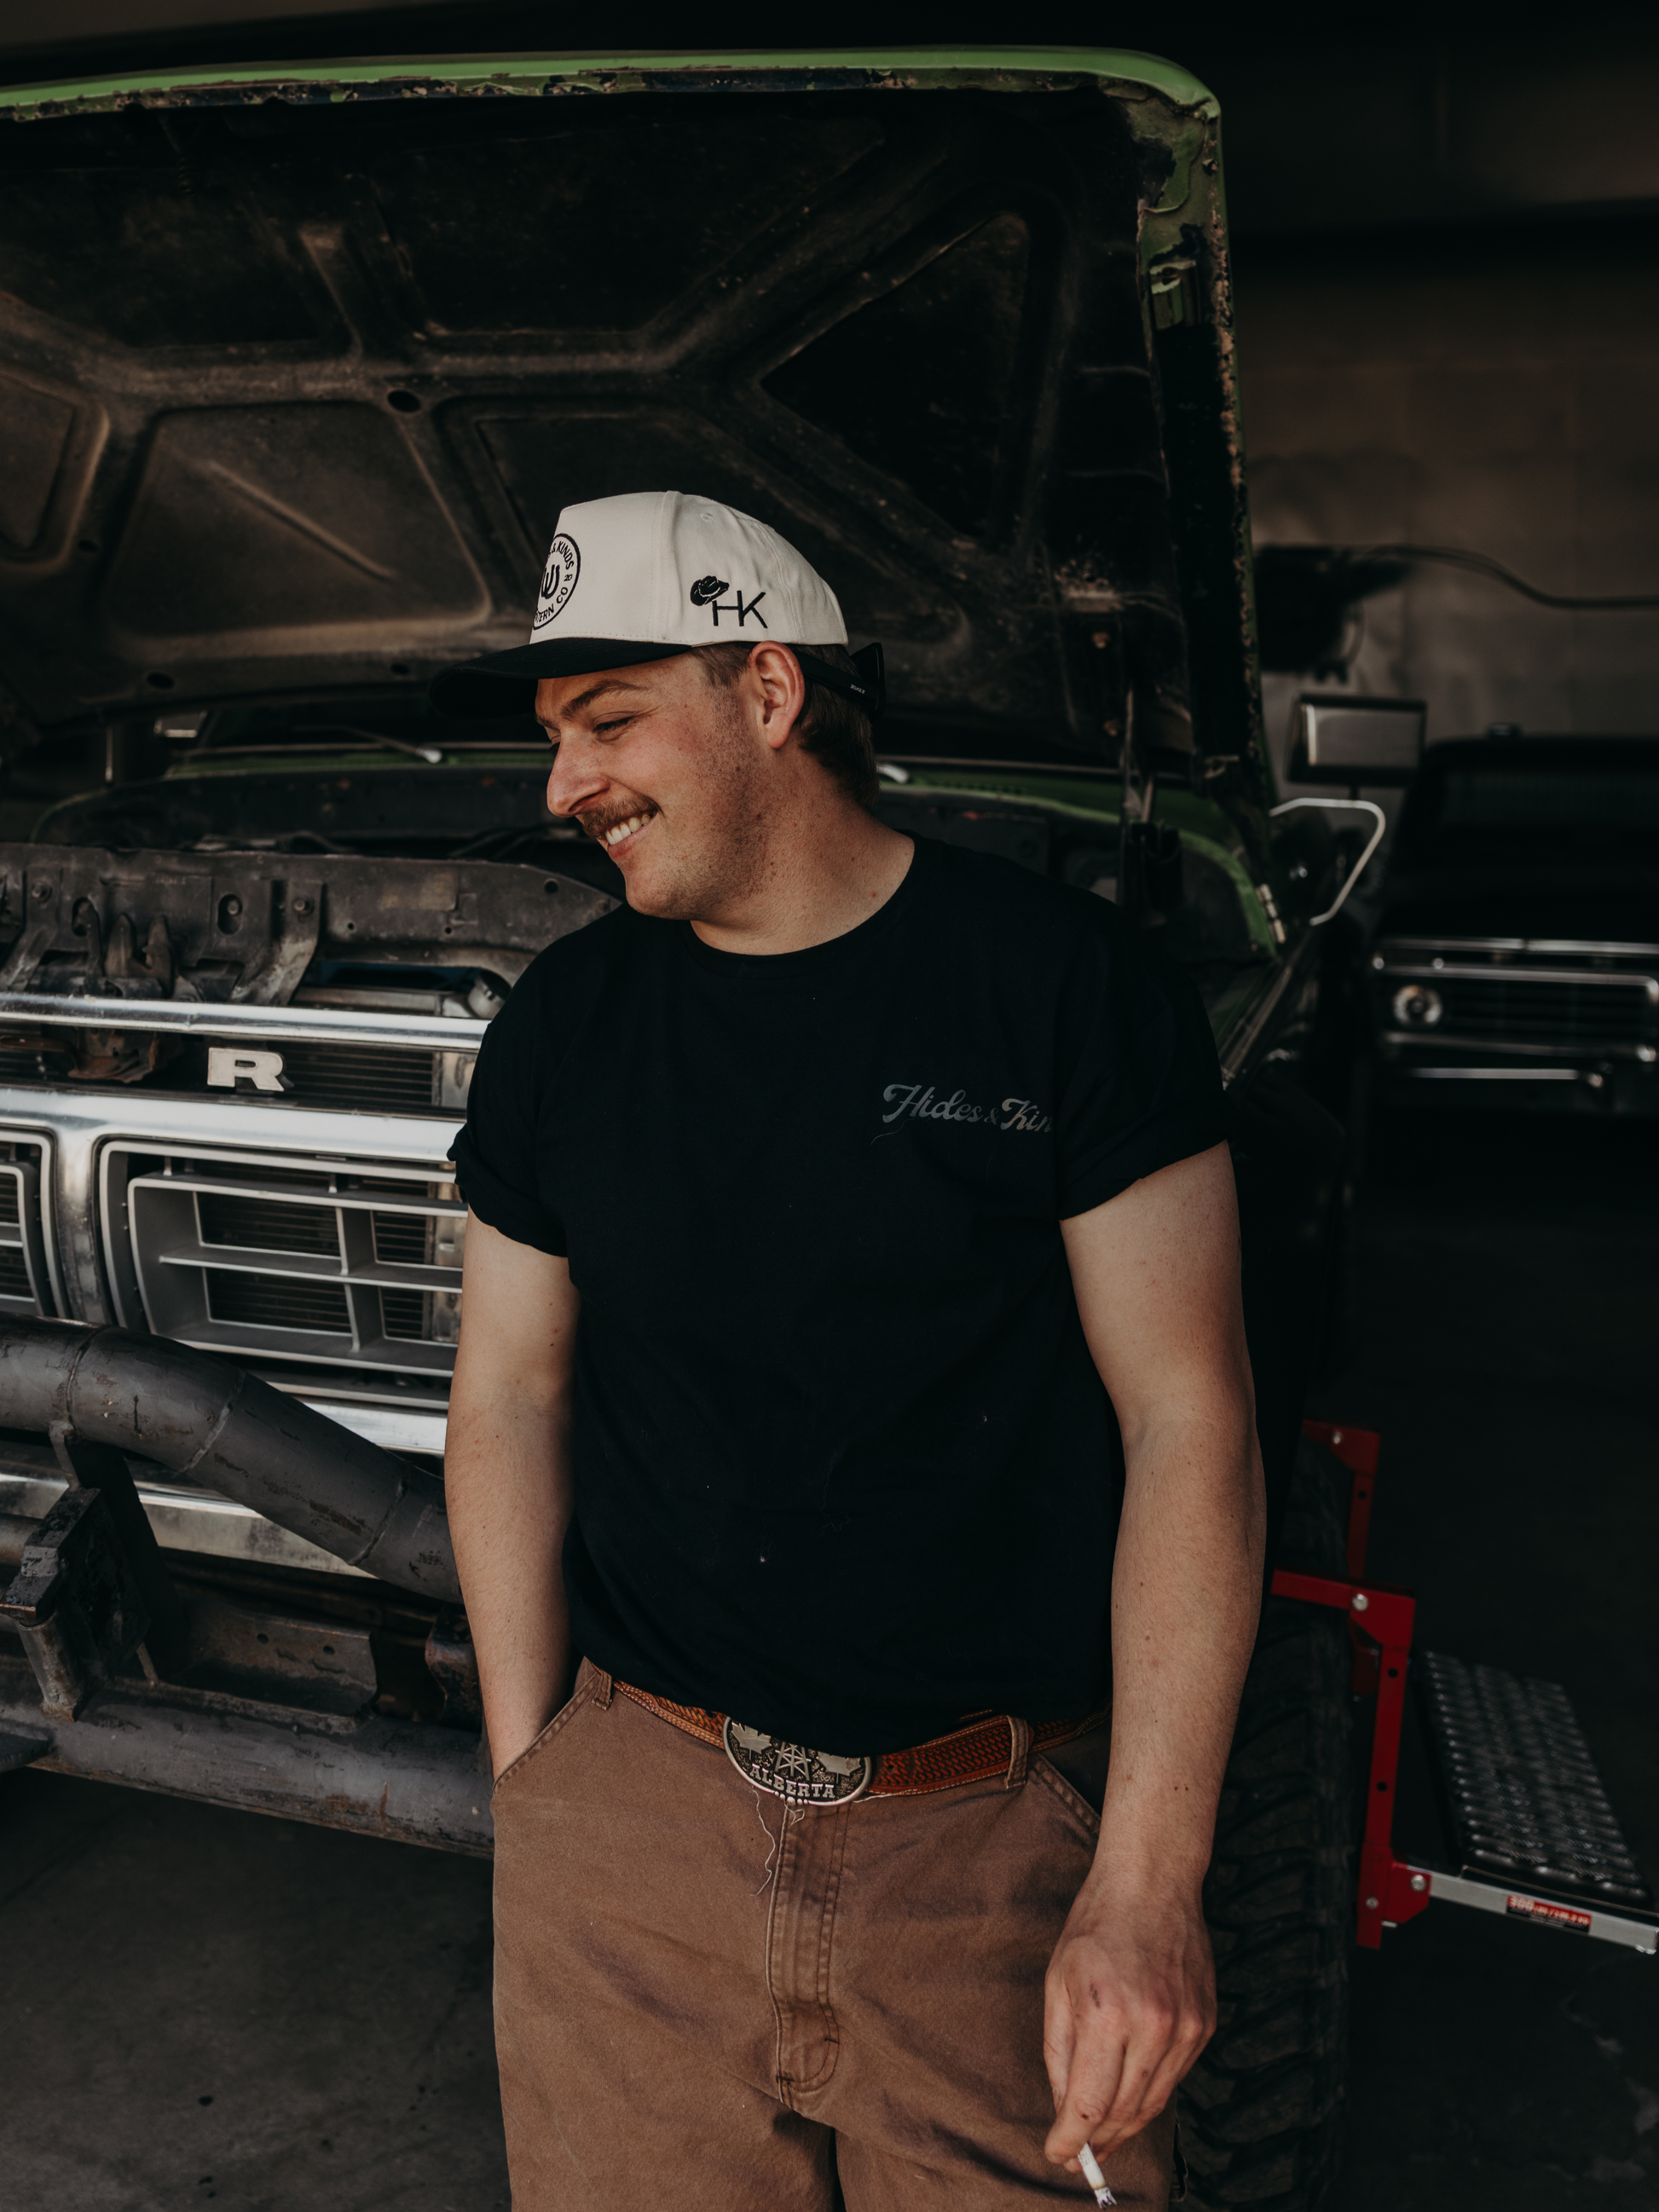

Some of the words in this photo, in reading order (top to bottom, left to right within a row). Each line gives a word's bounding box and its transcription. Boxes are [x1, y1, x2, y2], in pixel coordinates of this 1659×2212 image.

[556, 540, 575, 570] KINDS
[535, 603, 554, 623] TERN
[556, 586, 569, 604] CO
[712, 590, 768, 629] HK
[207, 1047, 285, 1092] R
[882, 1083, 983, 1123] Hides
[984, 1107, 999, 1125] &
[1000, 1098, 1052, 1133] Kin
[749, 1763, 836, 1799] ALBERTA
